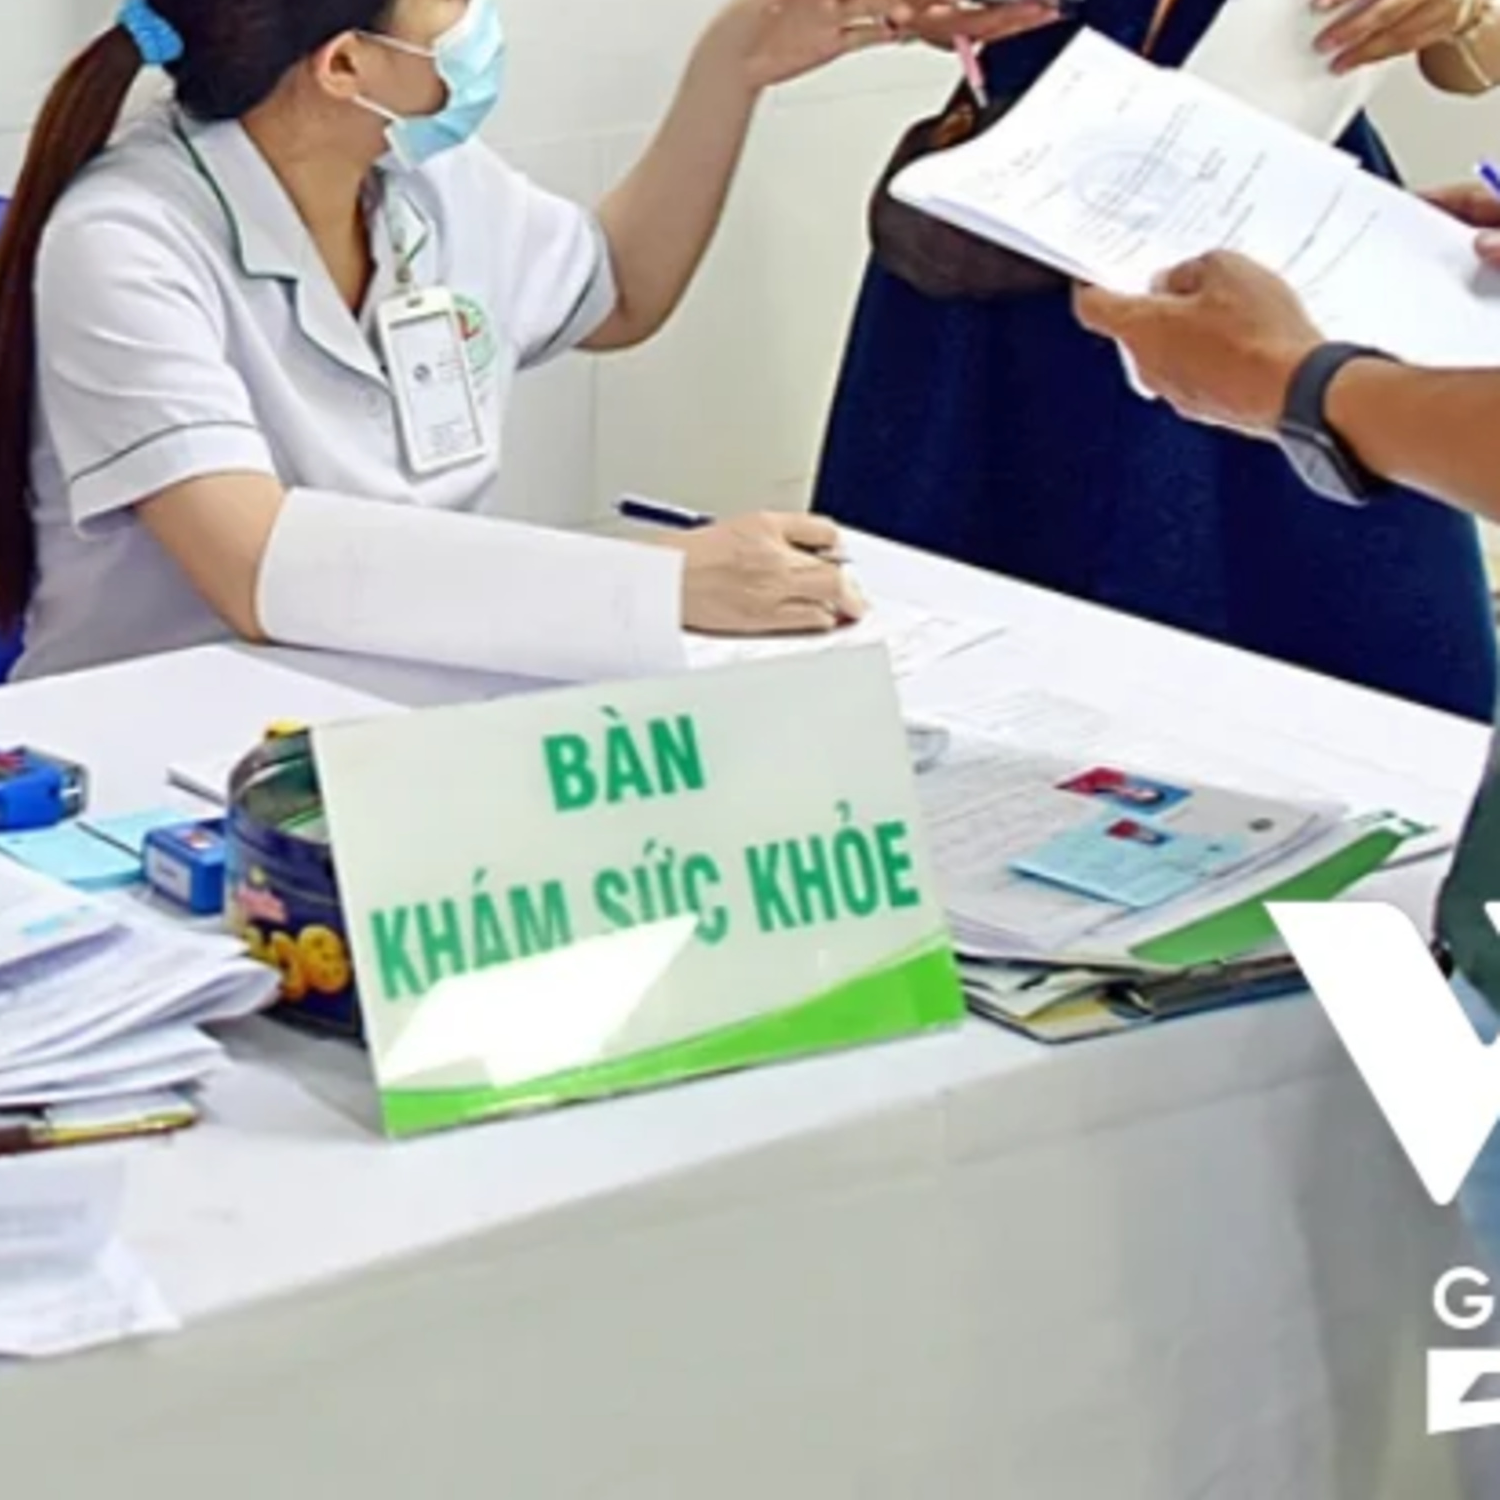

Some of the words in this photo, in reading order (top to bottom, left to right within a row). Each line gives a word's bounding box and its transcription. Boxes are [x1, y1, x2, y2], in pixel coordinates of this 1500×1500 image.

[543, 705, 706, 812] BÀN
[370, 869, 573, 1000] KHÁM
[593, 838, 729, 946] SỨC
[746, 801, 921, 933] KHỎE
